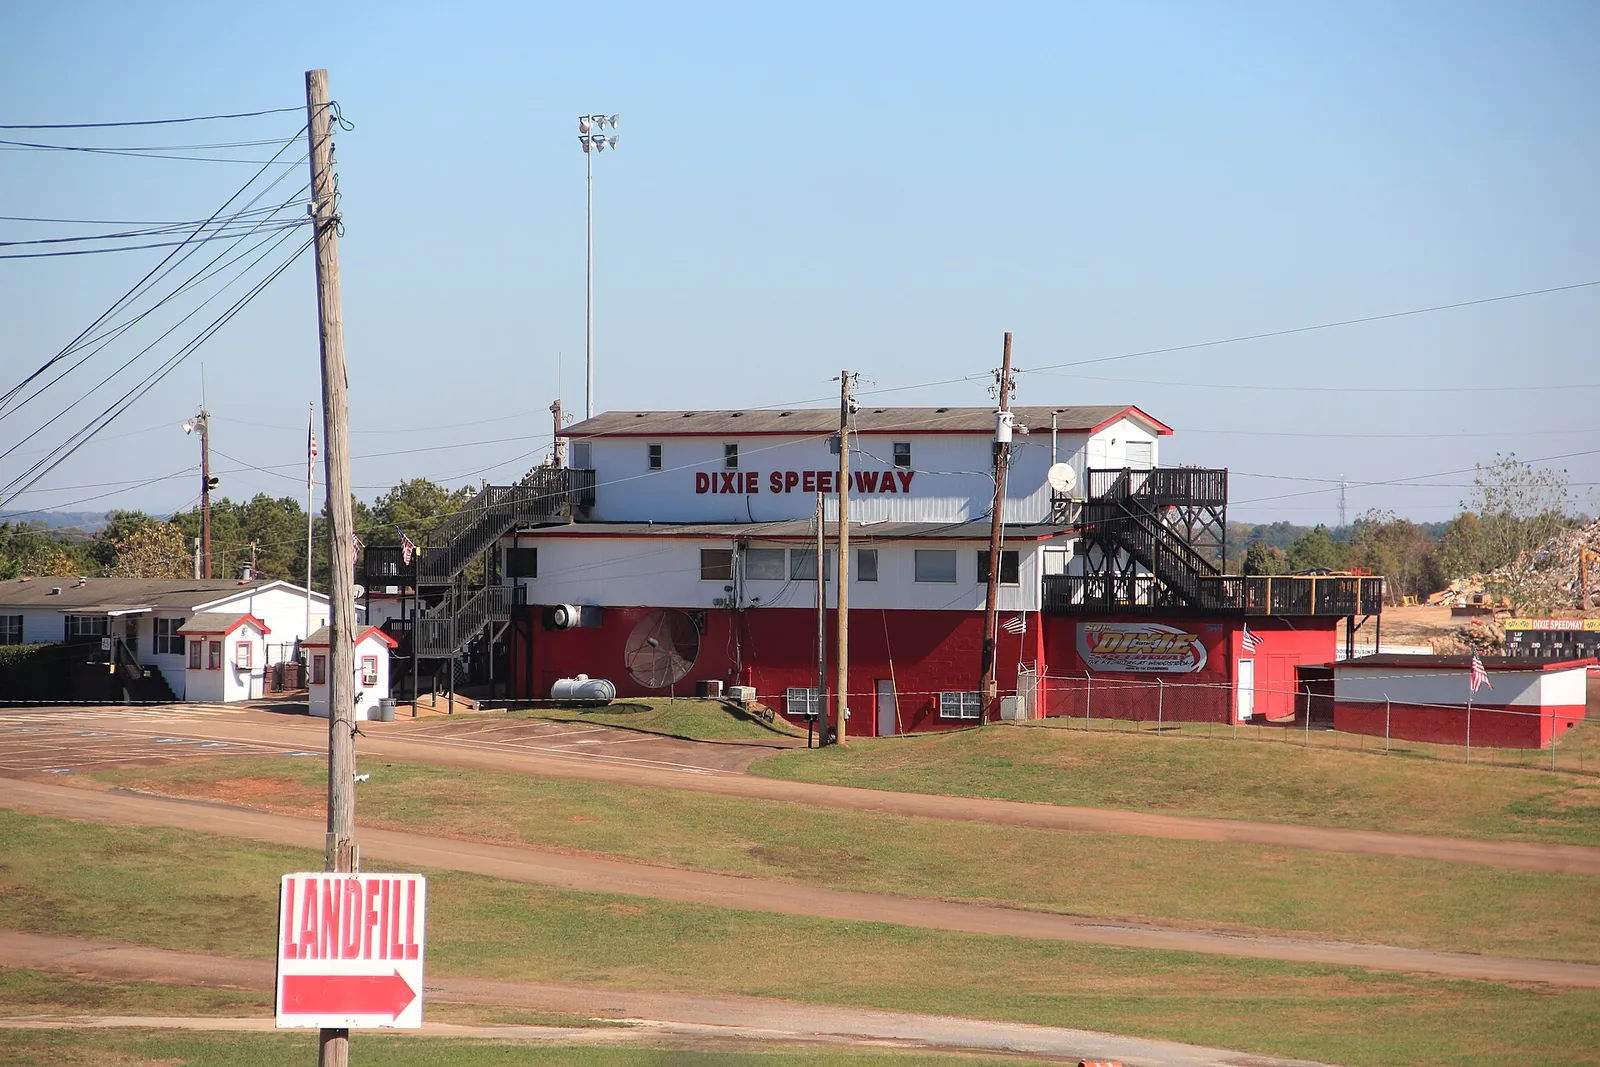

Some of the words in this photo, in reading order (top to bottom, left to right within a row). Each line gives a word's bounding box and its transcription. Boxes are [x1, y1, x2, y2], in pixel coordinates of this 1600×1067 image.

[695, 471, 760, 494] DIXIE
[769, 470, 915, 494] SPEEDWAY
[1533, 619, 1549, 630] DIXIE
[1549, 619, 1583, 630] SPEEDWAY
[1091, 633, 1199, 654] DIXIE
[283, 878, 419, 960] LANDFILL
